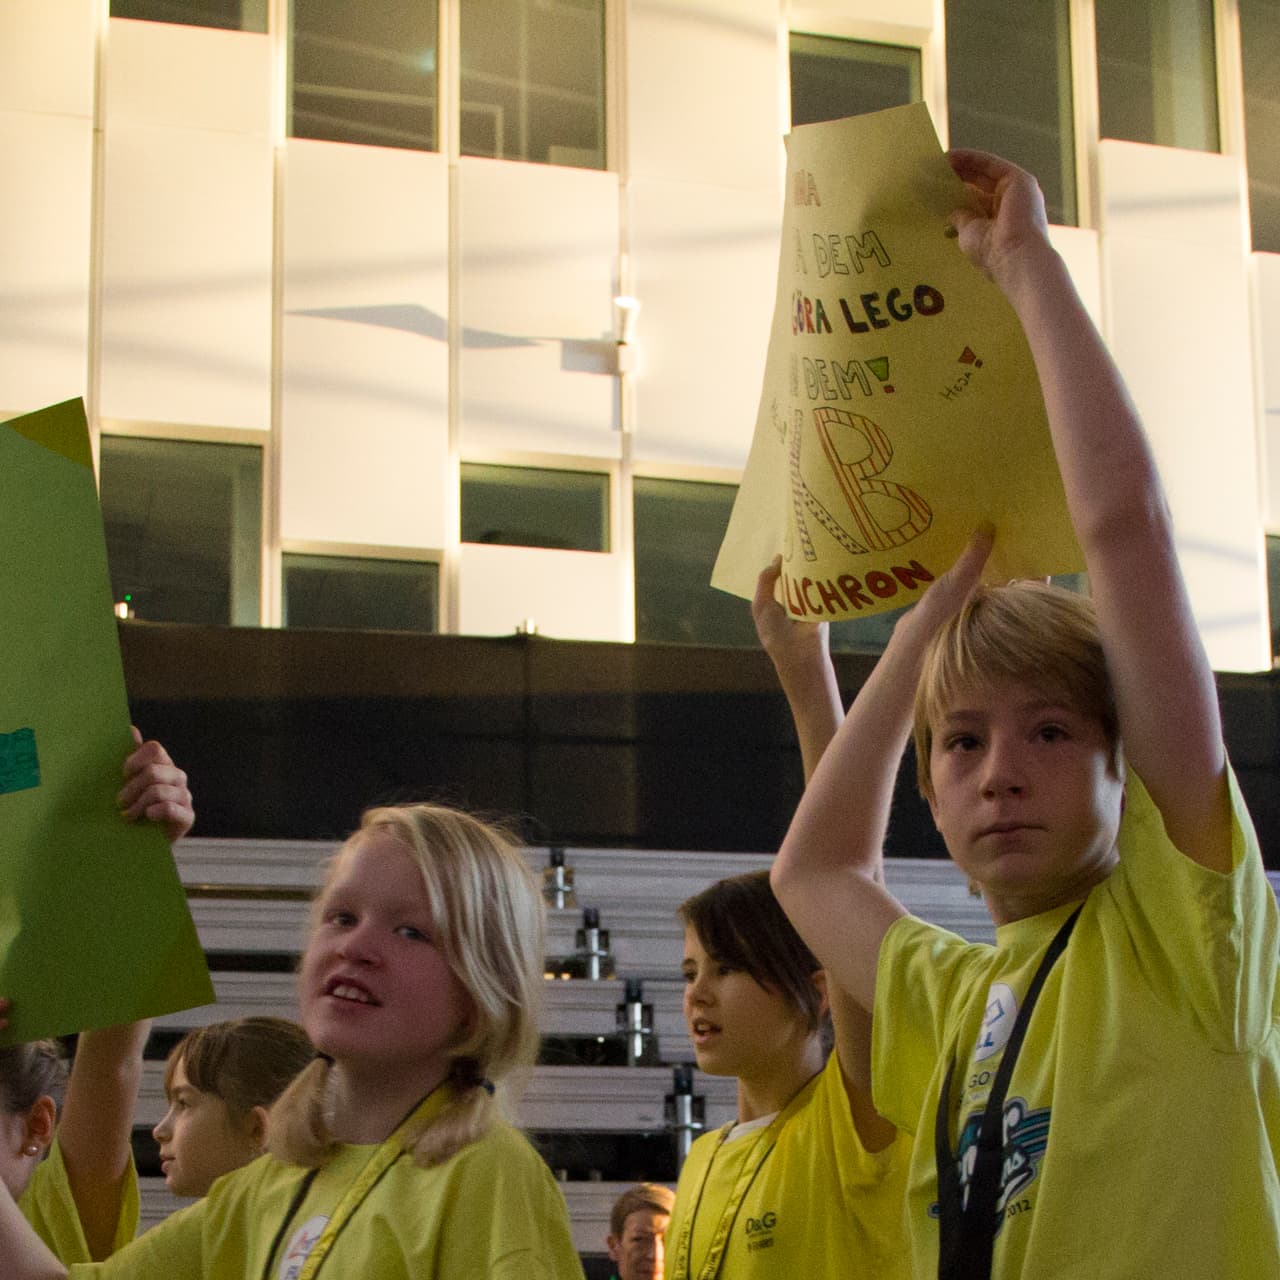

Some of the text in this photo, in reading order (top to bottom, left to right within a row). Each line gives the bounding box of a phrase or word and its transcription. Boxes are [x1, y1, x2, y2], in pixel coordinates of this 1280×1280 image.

[813, 230, 891, 278] DEM
[839, 284, 945, 334] LEGO
[802, 355, 895, 401] DEM!
[783, 559, 935, 617] LICHRON
